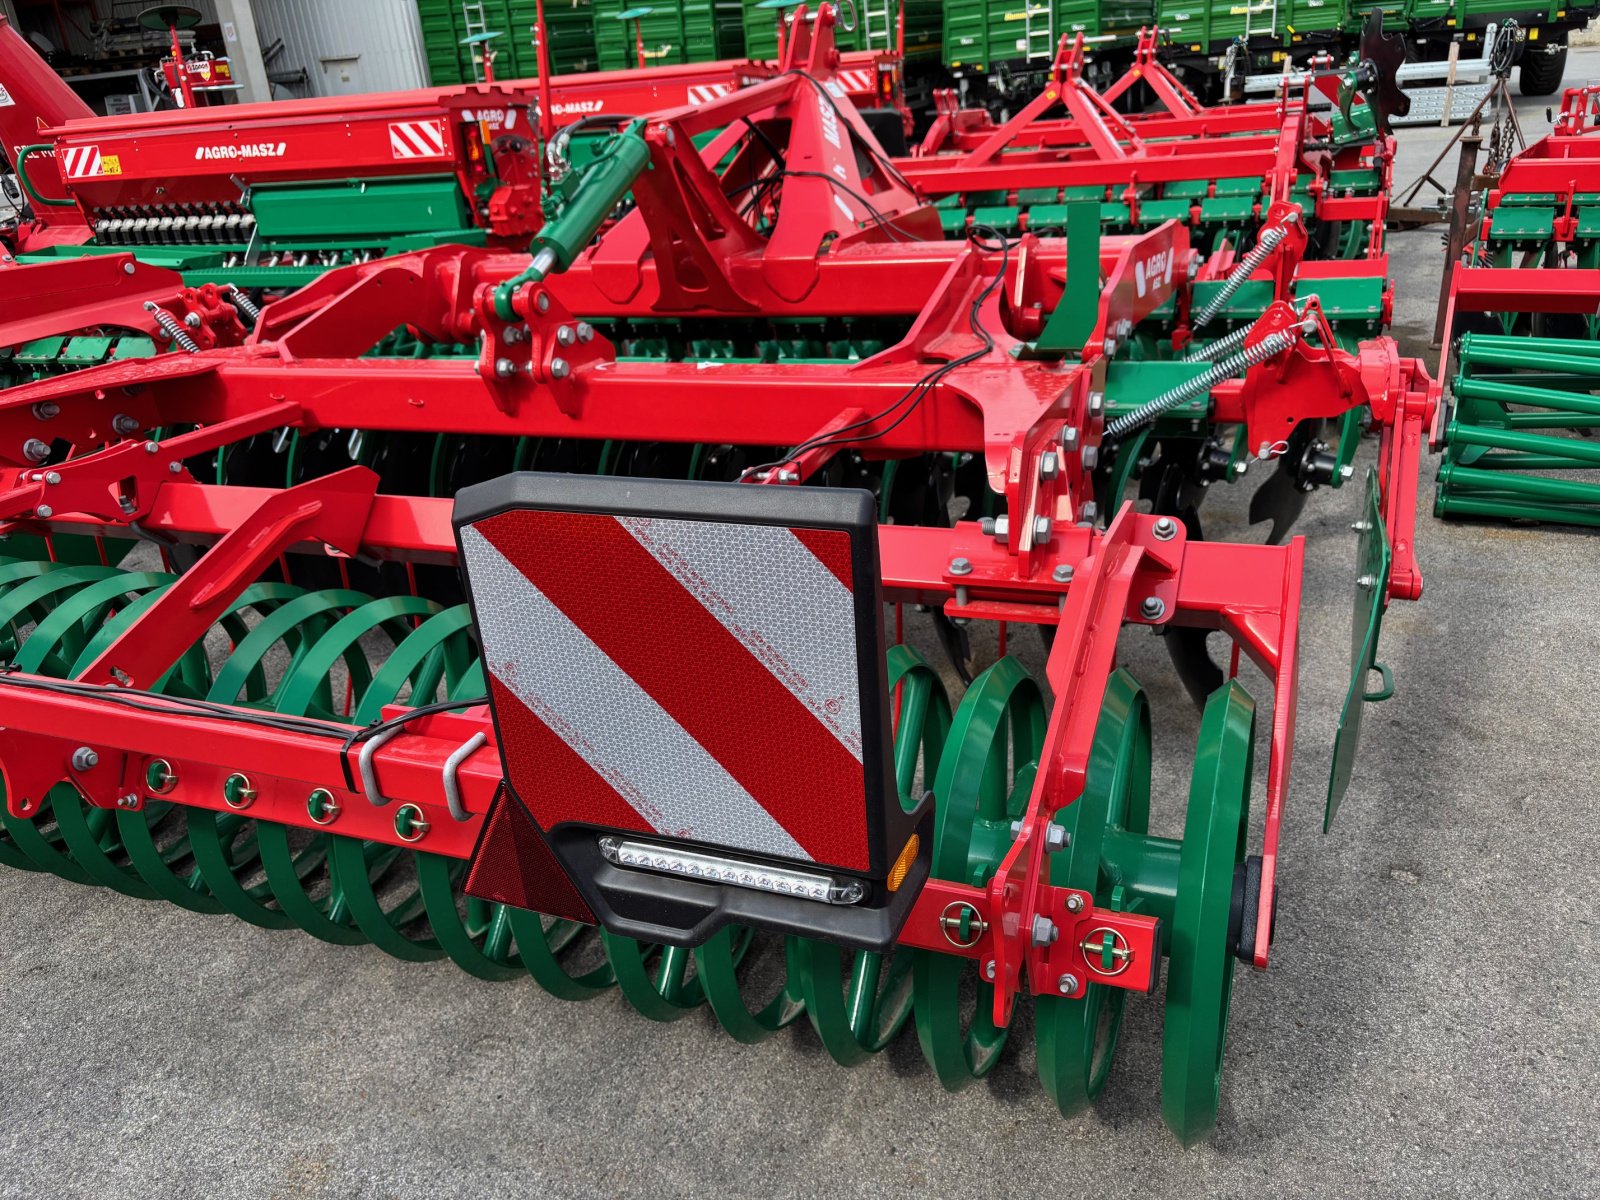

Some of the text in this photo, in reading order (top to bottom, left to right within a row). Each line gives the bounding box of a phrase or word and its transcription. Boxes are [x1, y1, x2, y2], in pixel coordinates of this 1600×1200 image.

[477, 108, 504, 122] AGRO
[205, 142, 276, 160] AGRO-MASZ
[1146, 251, 1166, 280] AGRO
